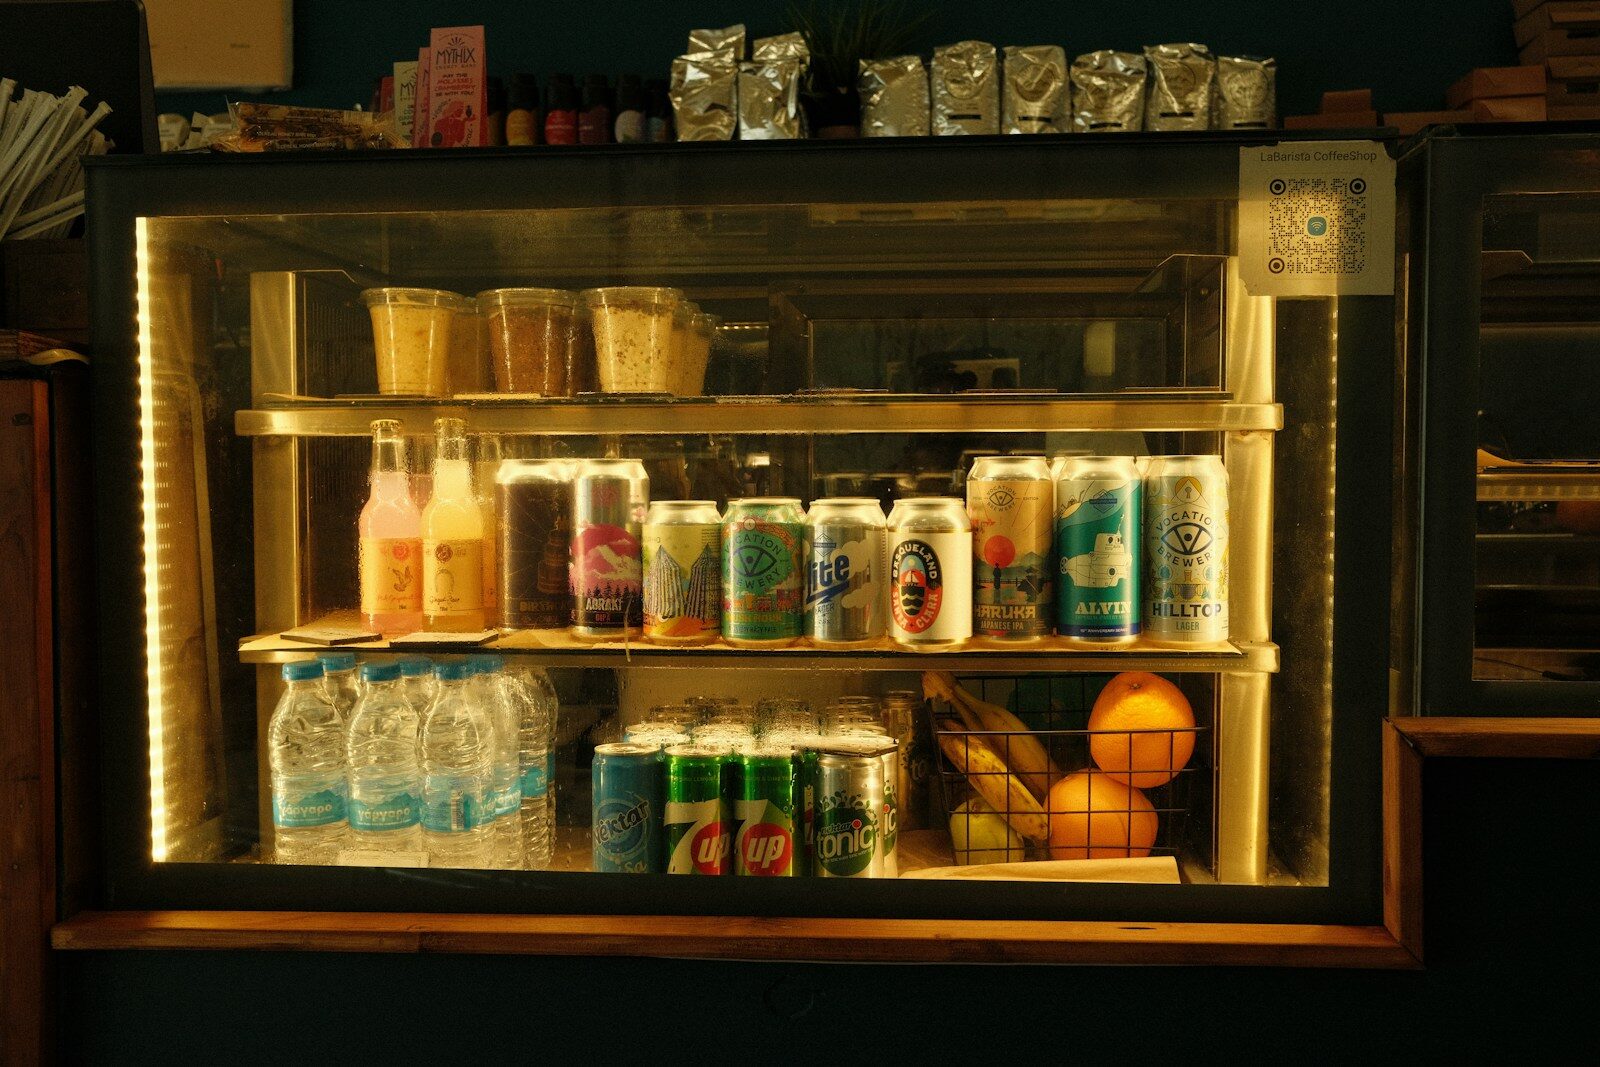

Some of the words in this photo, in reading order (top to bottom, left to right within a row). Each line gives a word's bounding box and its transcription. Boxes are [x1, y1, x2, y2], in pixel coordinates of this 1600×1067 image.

[436, 47, 476, 64] MYTHIX
[1260, 151, 1311, 162] LaBarista
[1313, 150, 1377, 163] CoffeeShop
[987, 485, 1017, 496] VOCATION
[986, 501, 1016, 512] BREWERY
[1156, 511, 1213, 532] VOCATIO
[892, 543, 938, 580] BASQUELAND
[1157, 546, 1213, 567] BREWER
[892, 591, 909, 629] SANTA
[916, 593, 939, 629] CLARA
[975, 605, 1036, 619] HARUKA
[1075, 601, 1132, 615] ALVIN
[1152, 602, 1222, 618] HILLTOP
[980, 620, 1011, 630] JAPANESE
[1012, 621, 1024, 630] IPA
[1176, 621, 1200, 631] LAGER
[816, 818, 874, 860] tonic
